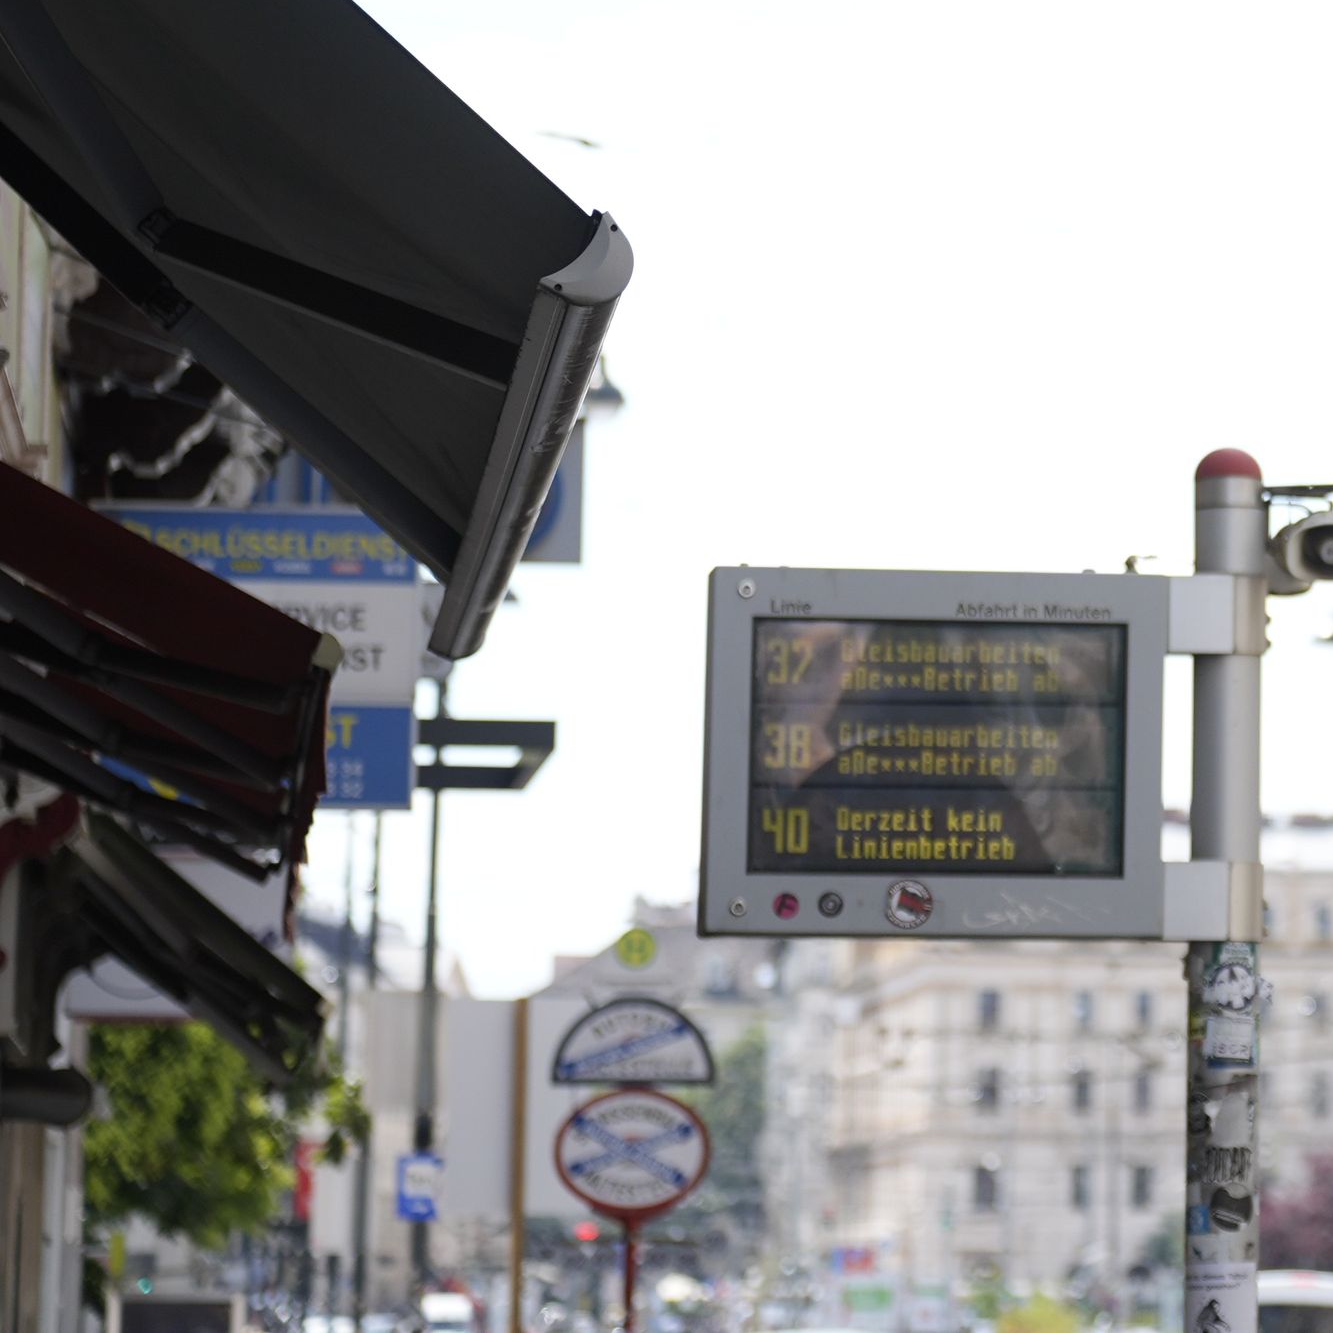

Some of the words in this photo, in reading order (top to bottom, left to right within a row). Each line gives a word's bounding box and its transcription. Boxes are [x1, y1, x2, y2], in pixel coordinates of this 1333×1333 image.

[156, 524, 408, 563] SCHLÜSSELDIENS
[770, 600, 813, 615] Linie
[955, 602, 1018, 617] Abfahrt
[1022, 604, 1038, 618] in
[1043, 604, 1112, 620] Minuten
[767, 637, 813, 685] 37
[840, 638, 1060, 665] Gleisbauarbeiten
[764, 722, 812, 769] 38
[839, 722, 1059, 749] Gleisbauarbeiten
[762, 807, 810, 855] 40
[836, 806, 934, 832] Derzeit
[947, 807, 1003, 833] kein
[836, 835, 1016, 861] Linienbetrieb
